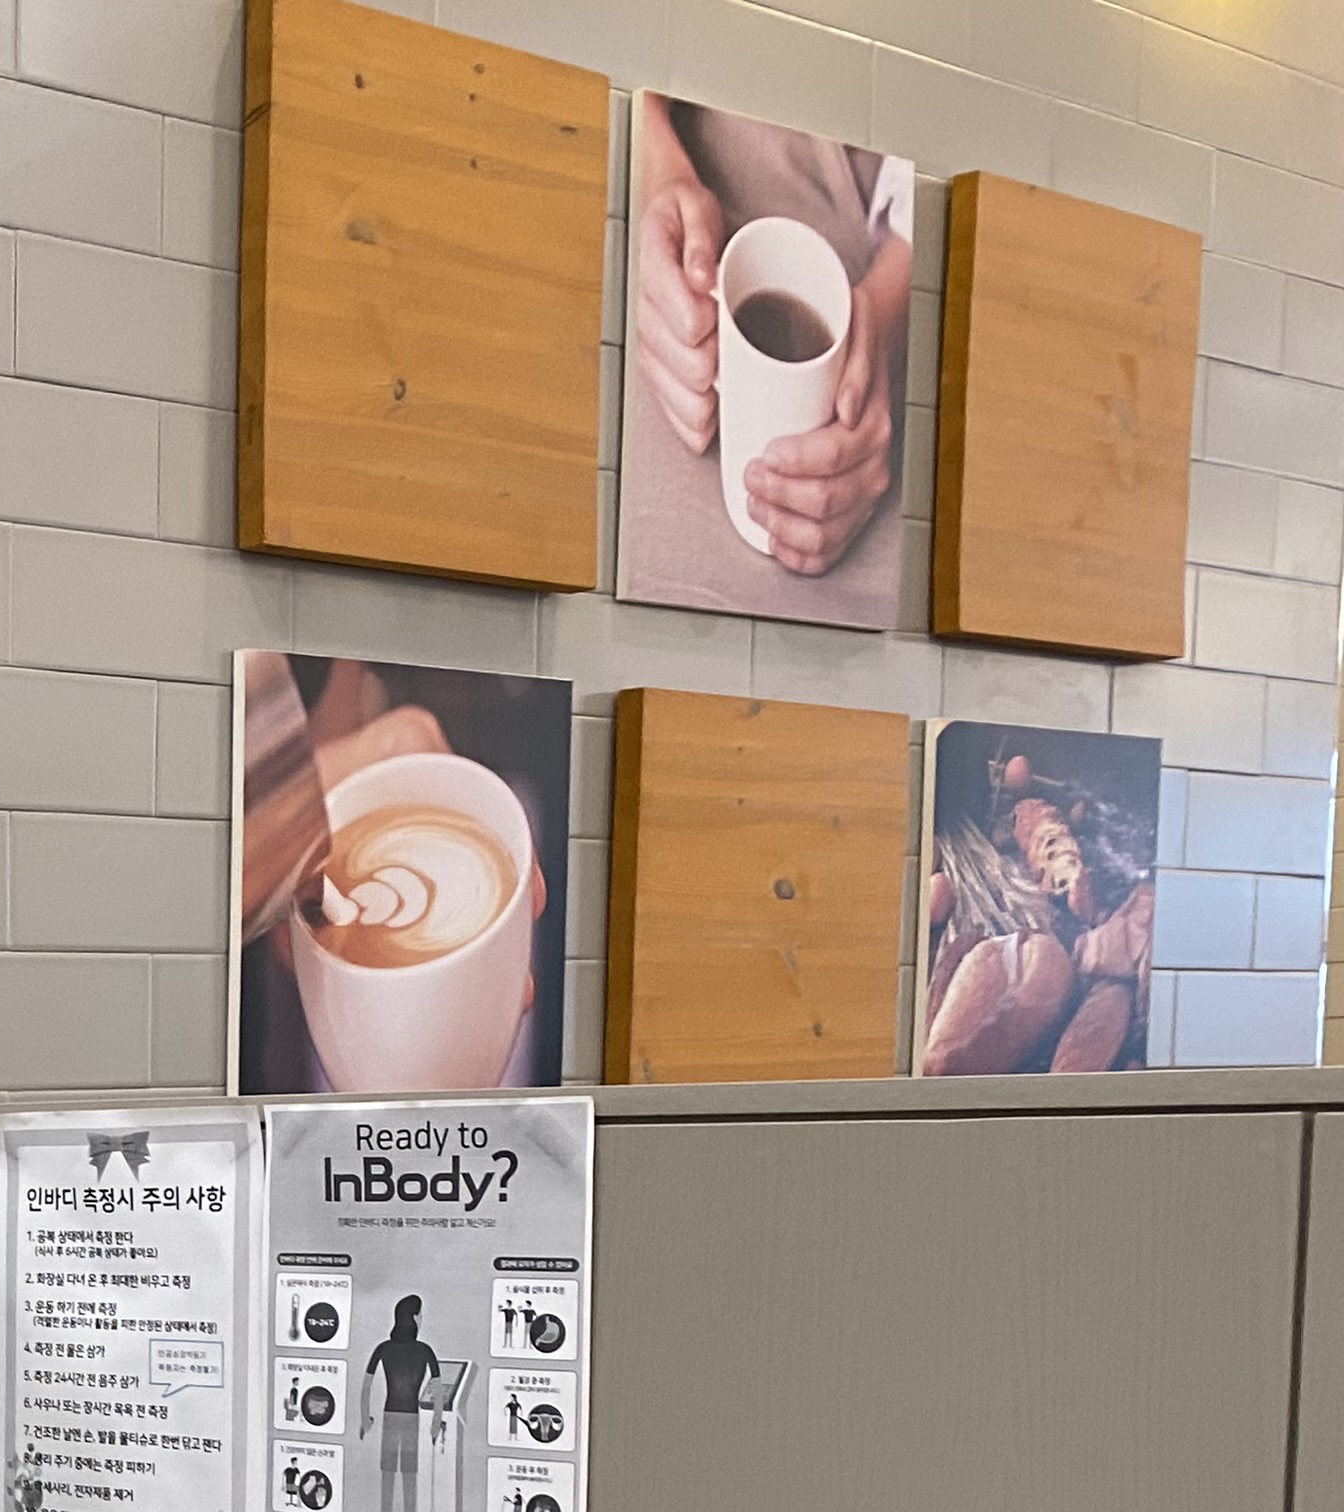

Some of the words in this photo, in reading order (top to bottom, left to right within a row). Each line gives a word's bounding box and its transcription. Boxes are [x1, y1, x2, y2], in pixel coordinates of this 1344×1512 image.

[356, 1121, 449, 1157] Ready
[458, 1122, 488, 1148] to
[324, 1150, 519, 1212] InBody?
[27, 1187, 77, 1212] 인바디
[82, 1187, 134, 1213] 측정시
[141, 1186, 180, 1212] 주의
[186, 1186, 227, 1212] 사항
[36, 1230, 55, 1244] 공복
[57, 1230, 94, 1244] 상태에서
[96, 1230, 113, 1245] 측정
[115, 1231, 134, 1245] 한다
[36, 1273, 65, 1287] 화장실
[99, 1274, 108, 1287] 후
[111, 1274, 139, 1289] 최대한
[140, 1275, 170, 1289] 비우고
[172, 1275, 191, 1290] 측정
[35, 1300, 54, 1314] 운동
[57, 1301, 75, 1314] 하기
[77, 1301, 96, 1316] 전에
[98, 1302, 117, 1316] 측정
[35, 1342, 53, 1356] 측정
[55, 1343, 65, 1357] 전
[34, 1370, 52, 1384] 측정
[54, 1372, 85, 1387] 24시간
[87, 1373, 96, 1387] 전
[98, 1374, 118, 1388] 음주
[120, 1375, 140, 1389] 삼가
[34, 1398, 61, 1411] 사우나
[62, 1400, 82, 1415] 또는
[83, 1401, 112, 1416] 장시간
[114, 1402, 133, 1417] 목욕
[136, 1404, 146, 1418] 전
[148, 1405, 169, 1420] 측정
[33, 1425, 61, 1441] 건조한
[119, 1431, 159, 1447] 물티슈로
[54, 1454, 73, 1468] 주기
[74, 1456, 102, 1473] 중에는
[104, 1458, 124, 1474] 측정
[126, 1460, 156, 1475] 피하기
[113, 1488, 134, 1502] 제거
